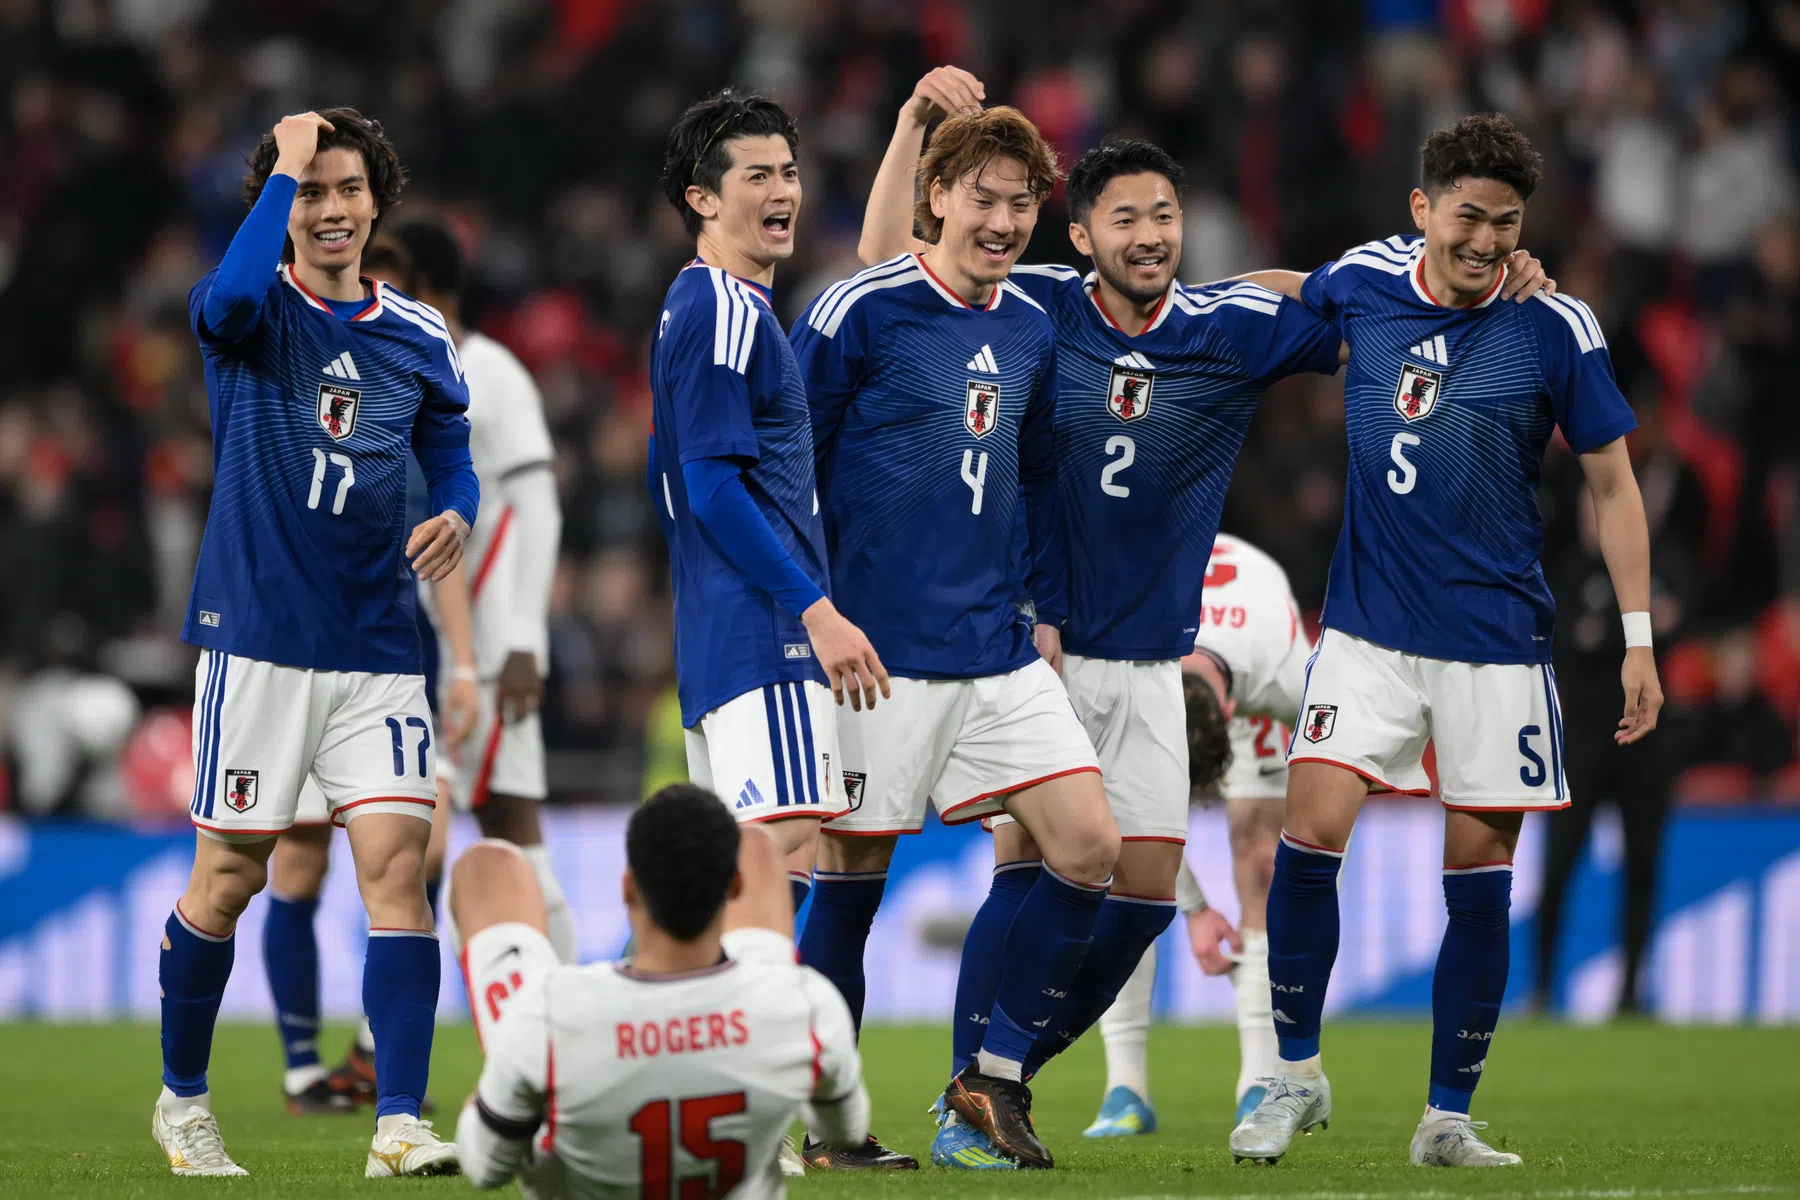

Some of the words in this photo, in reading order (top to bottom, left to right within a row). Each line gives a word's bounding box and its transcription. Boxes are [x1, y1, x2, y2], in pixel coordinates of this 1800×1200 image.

[329, 387, 351, 396] JAPAN
[974, 383, 992, 391] JAPAN
[1412, 367, 1432, 378] JAPAN
[972, 420, 987, 430] JFA
[1117, 404, 1136, 415] JFA
[1403, 403, 1421, 414] JFA
[307, 447, 355, 515] 17
[960, 448, 988, 515] 4
[1100, 435, 1136, 498] 2
[1387, 432, 1421, 494] 5
[385, 716, 430, 778] 17
[1517, 725, 1547, 787] 5
[614, 1009, 749, 1059] ROGERS
[630, 1091, 747, 1200] 15
